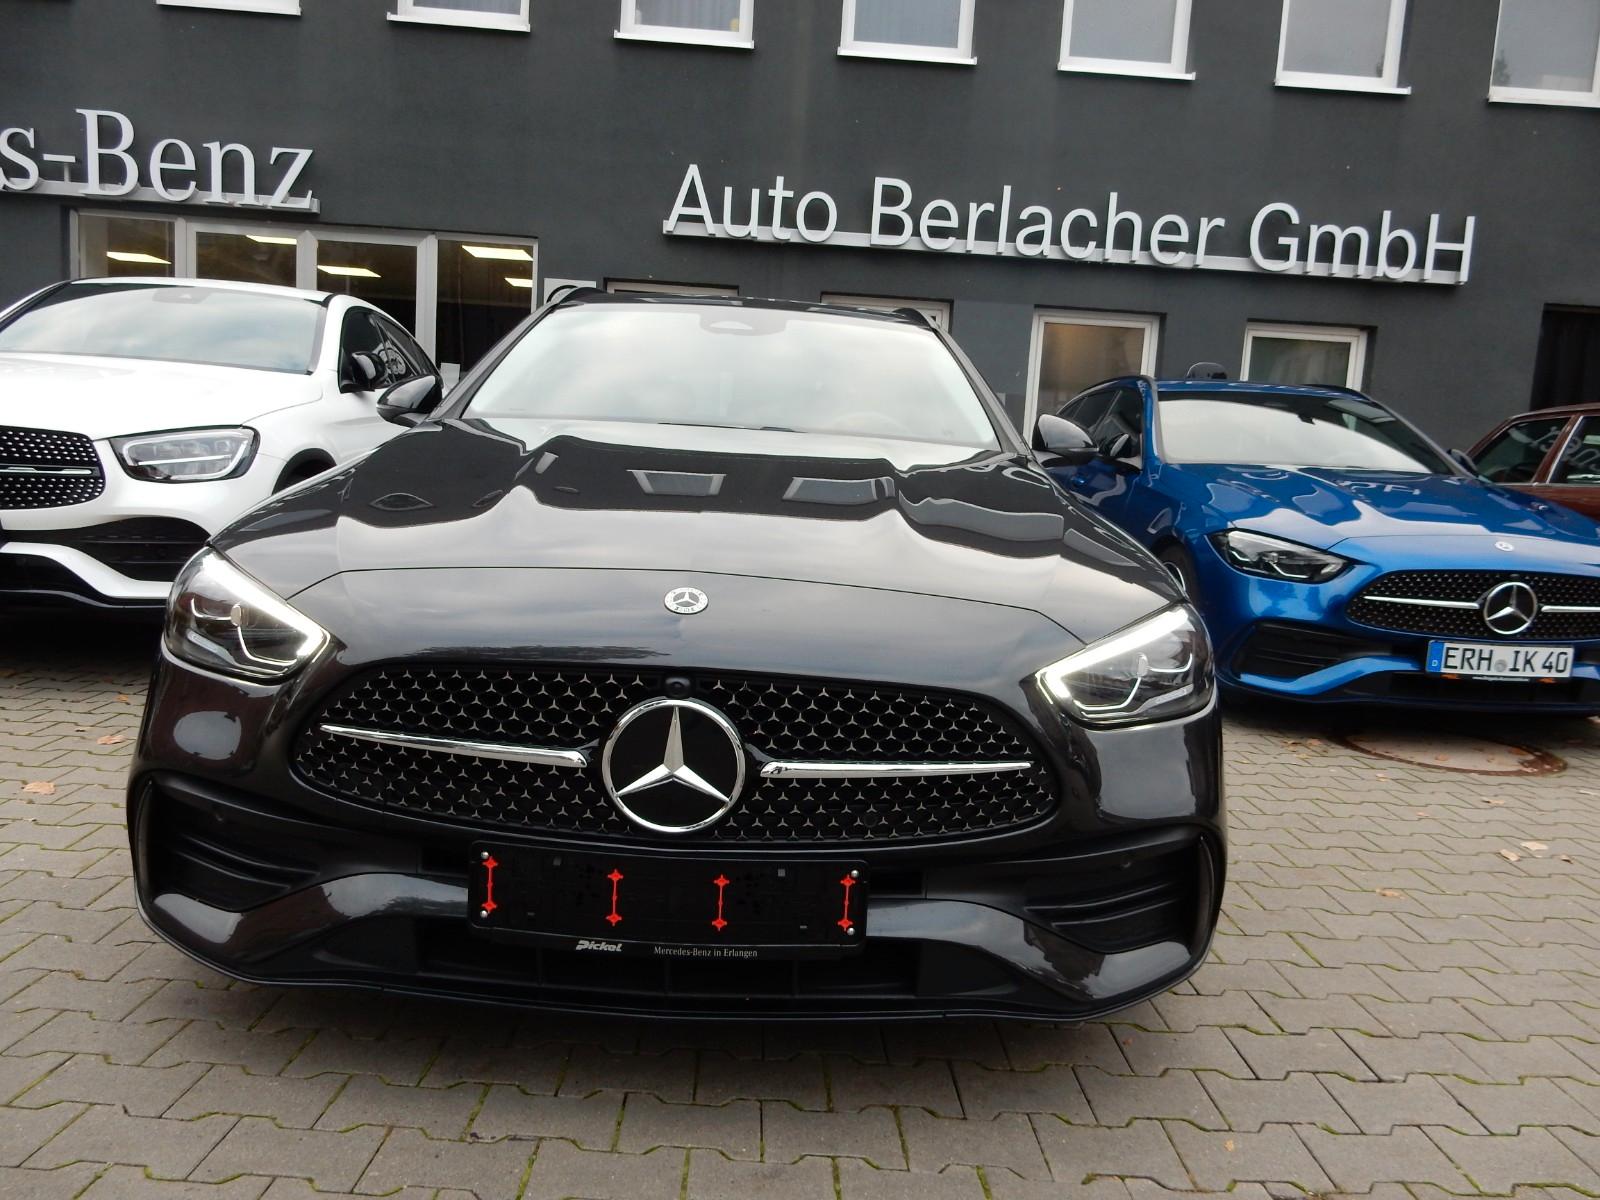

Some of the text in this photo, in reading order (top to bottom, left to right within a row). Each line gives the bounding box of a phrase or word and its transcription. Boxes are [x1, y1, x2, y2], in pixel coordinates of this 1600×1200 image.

[665, 163, 1476, 284] Auto Berlacher GmbH
[1443, 647, 1494, 671] ERH
[1541, 651, 1569, 674] 40
[575, 939, 623, 952] Pickel
[653, 946, 758, 959] Mercedes-Benz in Erlangen
